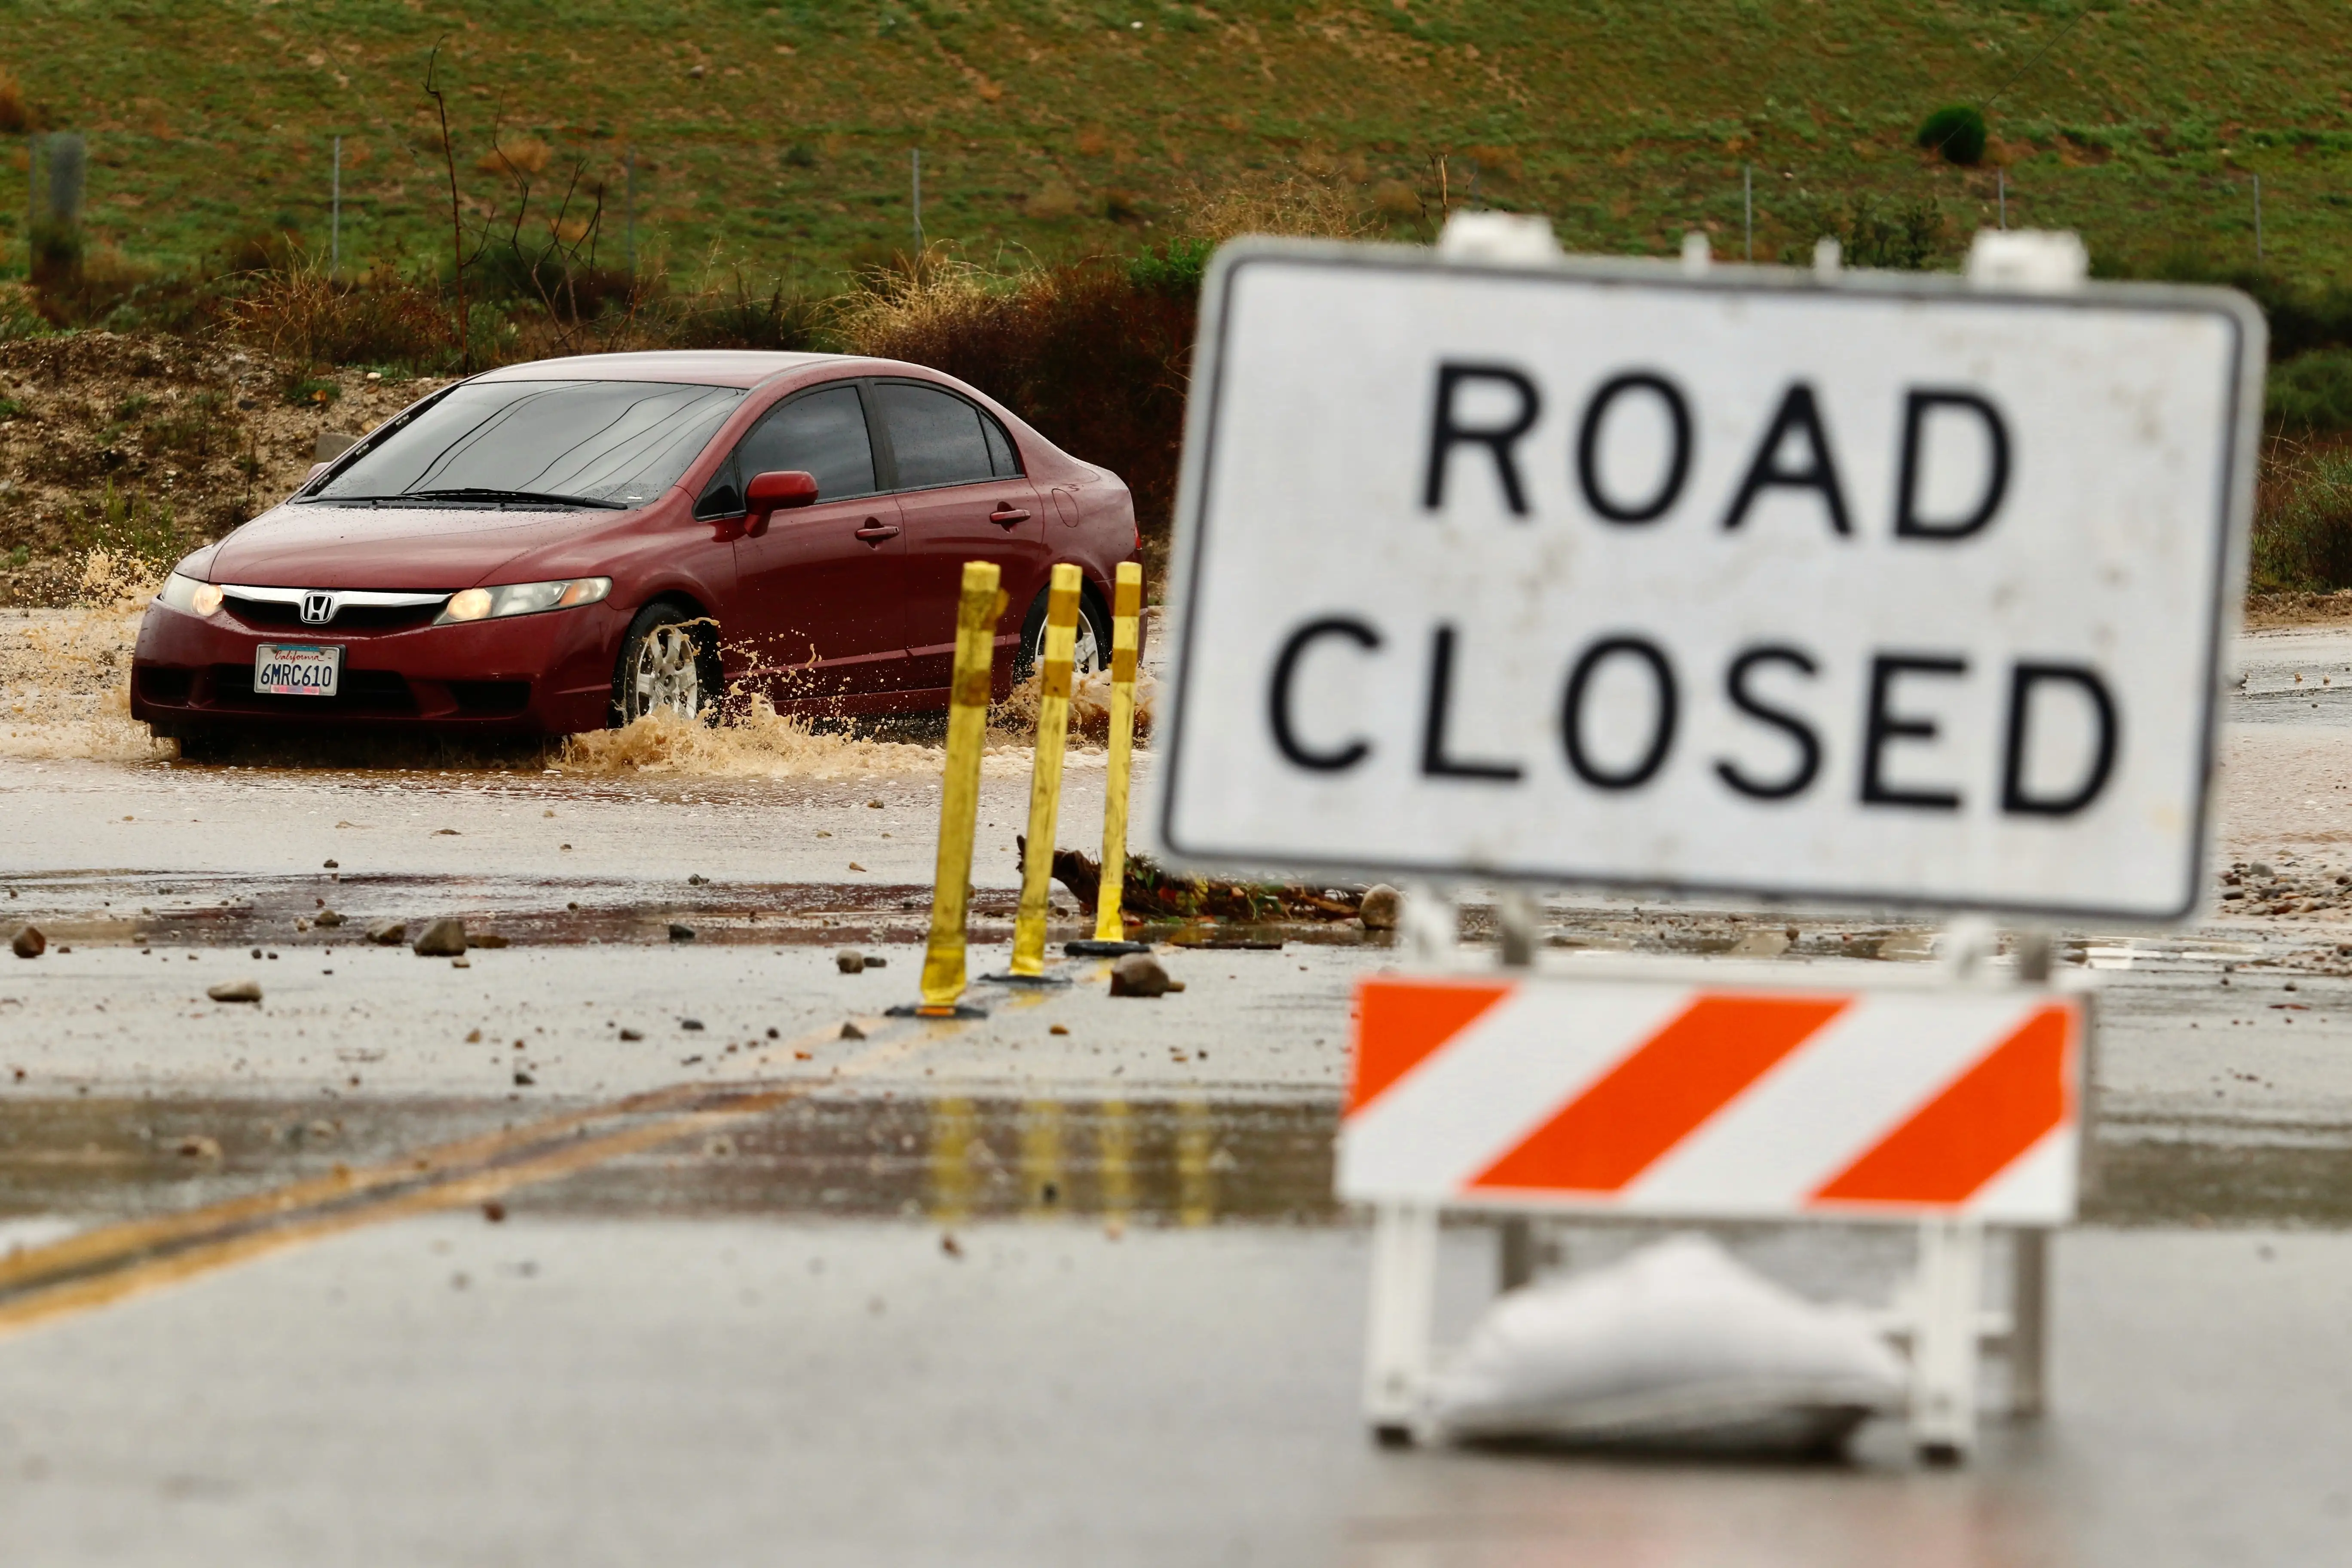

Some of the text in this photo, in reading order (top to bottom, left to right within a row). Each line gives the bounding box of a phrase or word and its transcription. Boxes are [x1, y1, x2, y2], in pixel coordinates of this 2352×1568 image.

[1422, 360, 2013, 544] ROAD
[260, 664, 332, 687] 6MRC610
[275, 650, 324, 664] California
[1267, 615, 2121, 821] CLOSED
